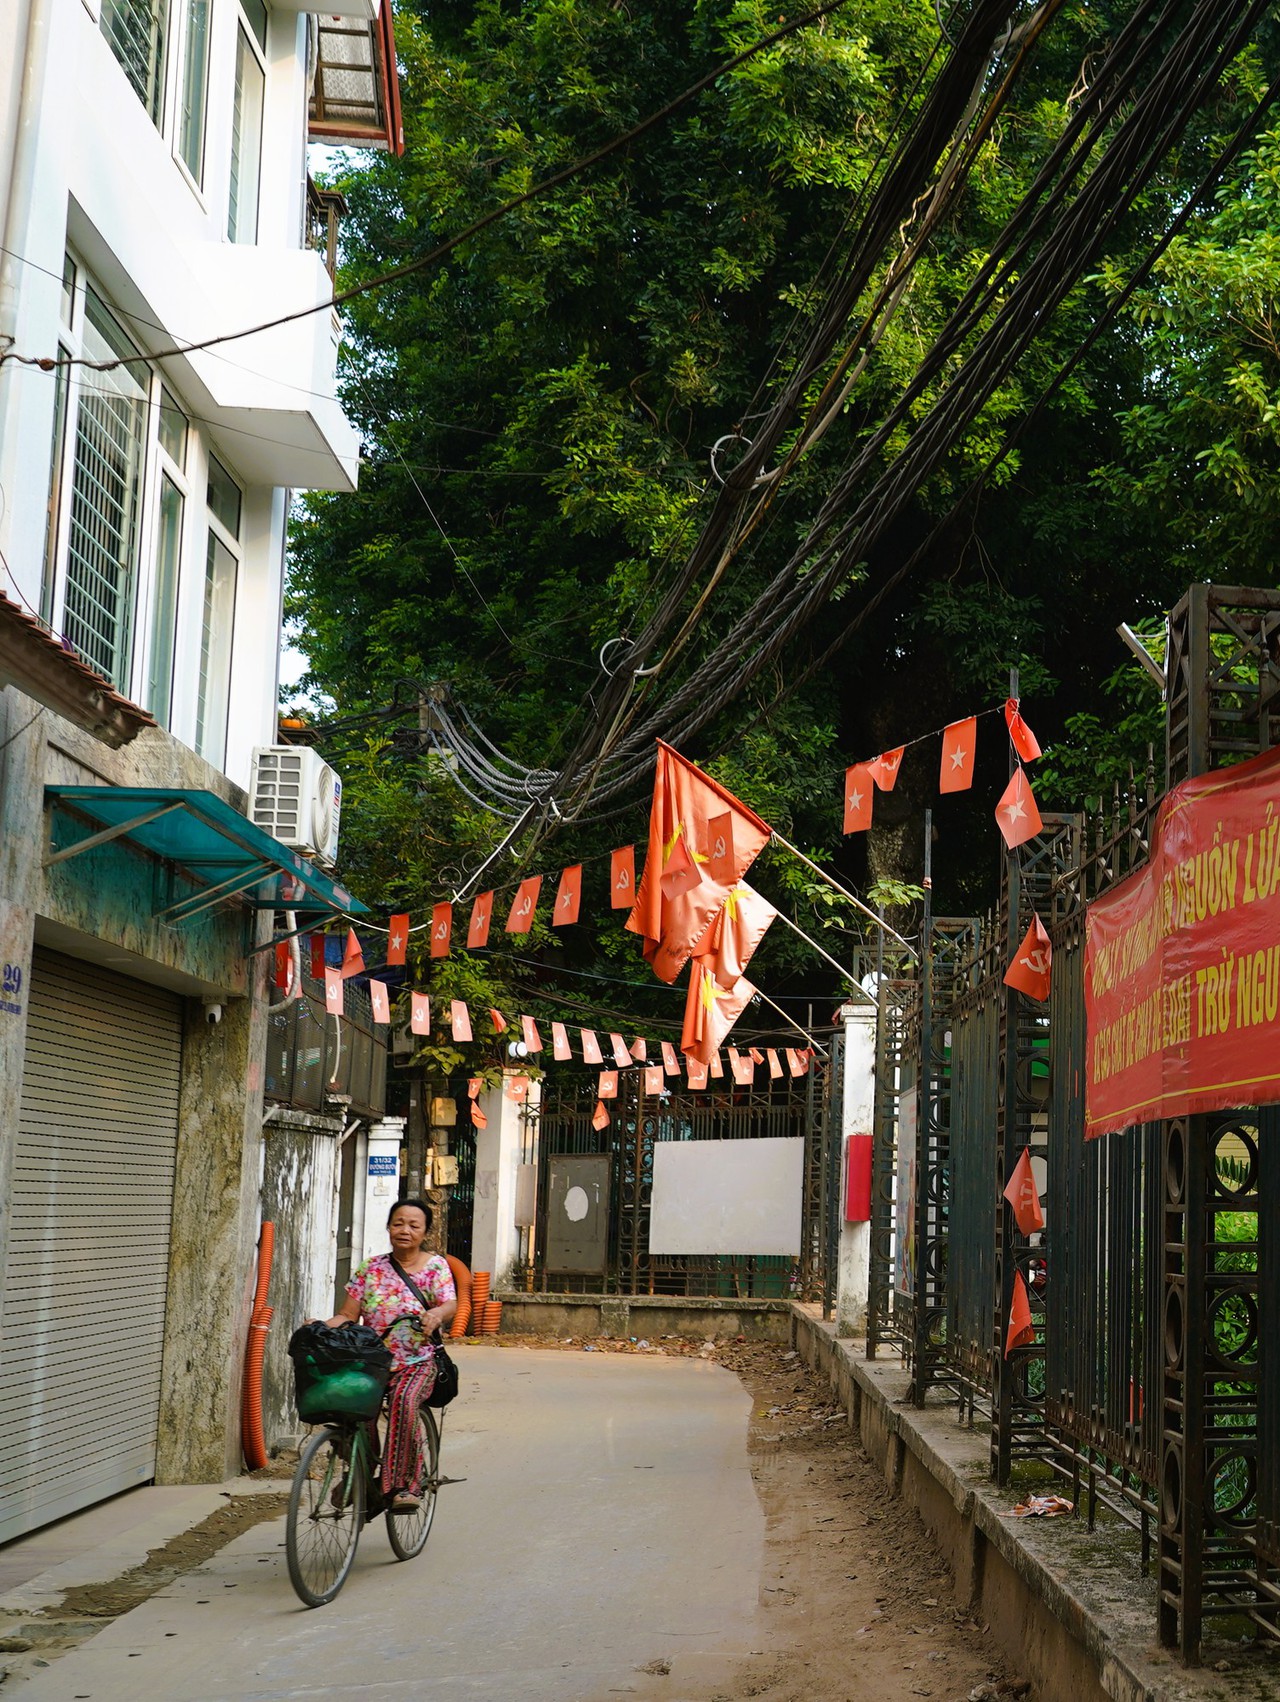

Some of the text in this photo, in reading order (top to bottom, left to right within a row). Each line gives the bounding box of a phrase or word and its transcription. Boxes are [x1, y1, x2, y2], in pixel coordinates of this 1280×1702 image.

[1174, 820, 1240, 931] NGUỒN
[2, 963, 21, 994] 29
[1162, 971, 1191, 1060] LOẠI
[1195, 945, 1235, 1038] TRỪ
